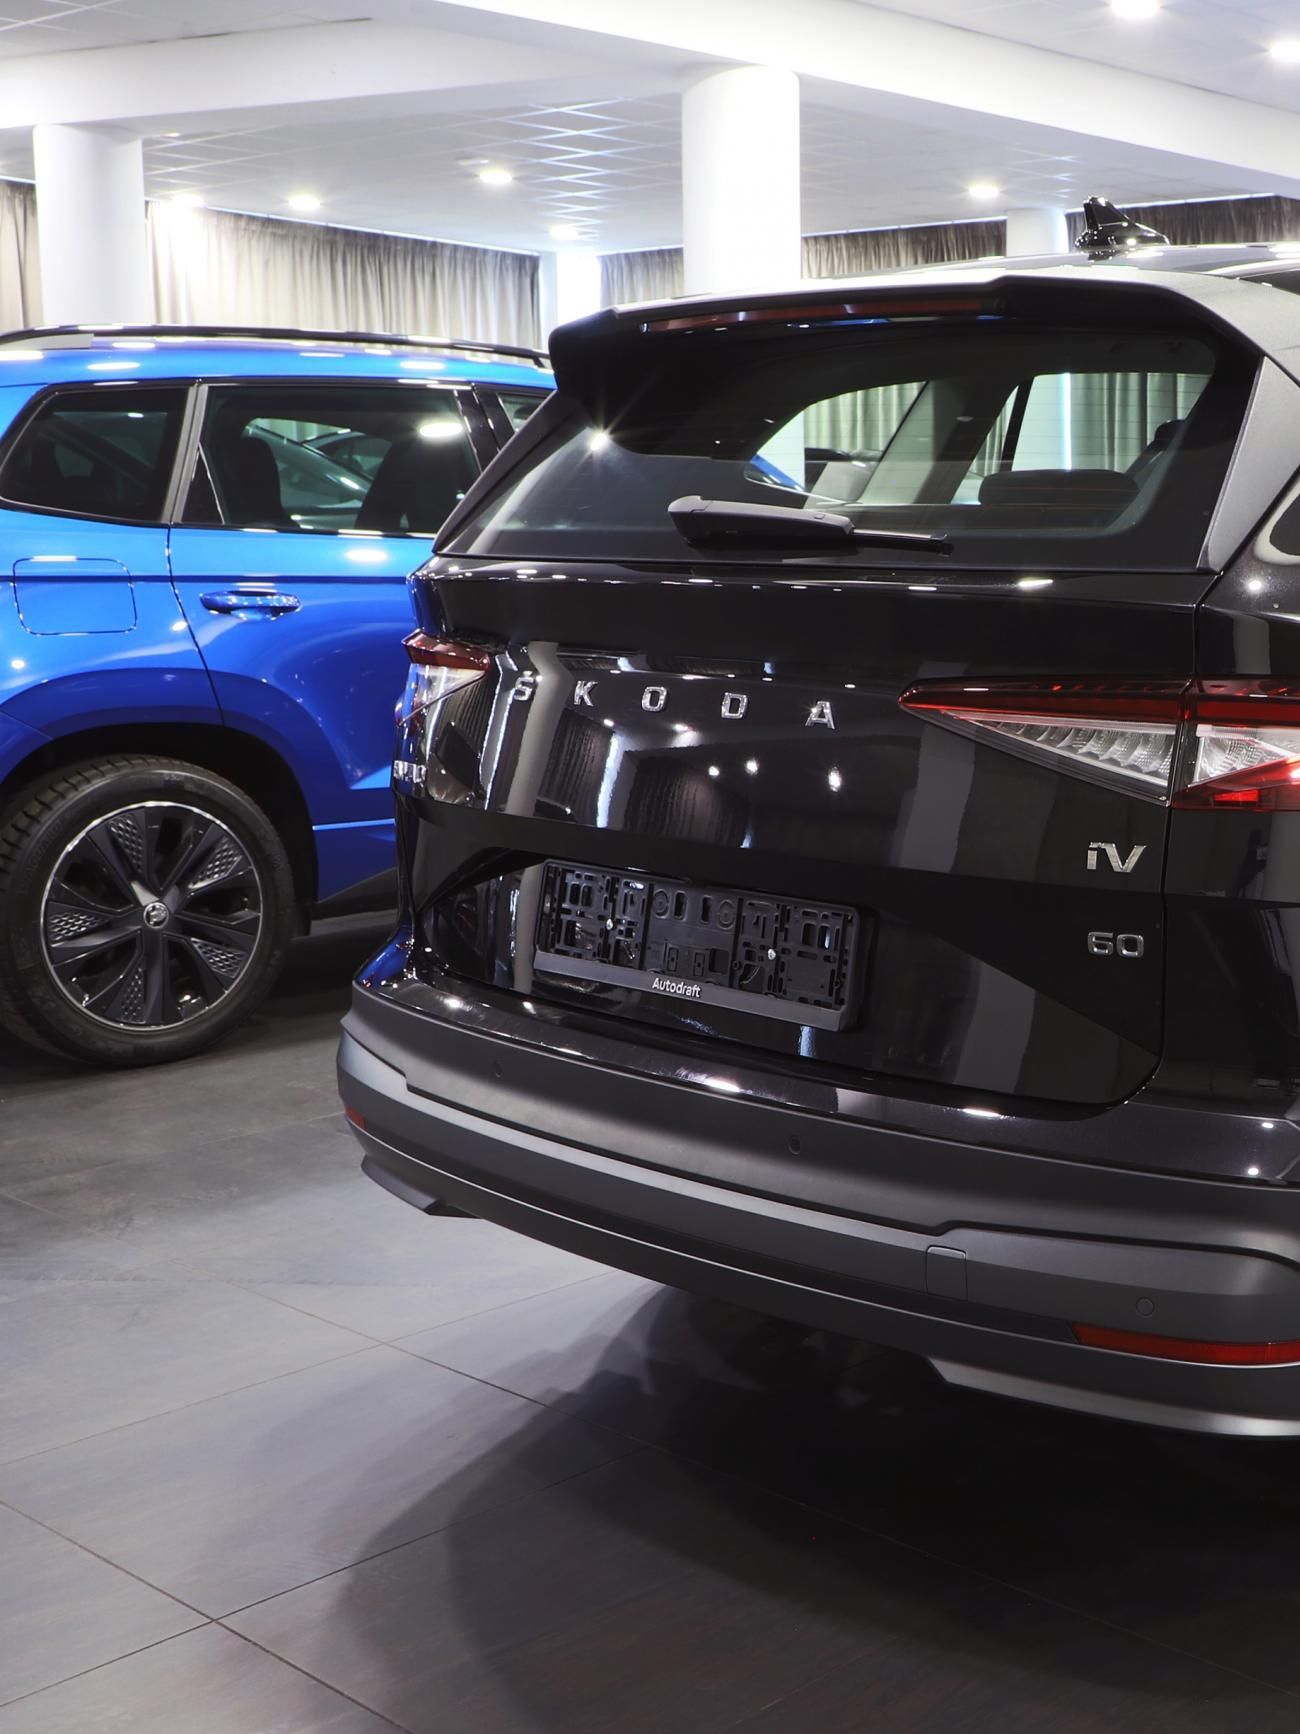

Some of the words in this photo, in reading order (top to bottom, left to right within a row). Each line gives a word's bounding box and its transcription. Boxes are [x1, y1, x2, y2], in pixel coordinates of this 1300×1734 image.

[513, 670, 836, 730] ŠKODA
[1087, 931, 1145, 958] 60
[652, 977, 701, 998] Autodraft
